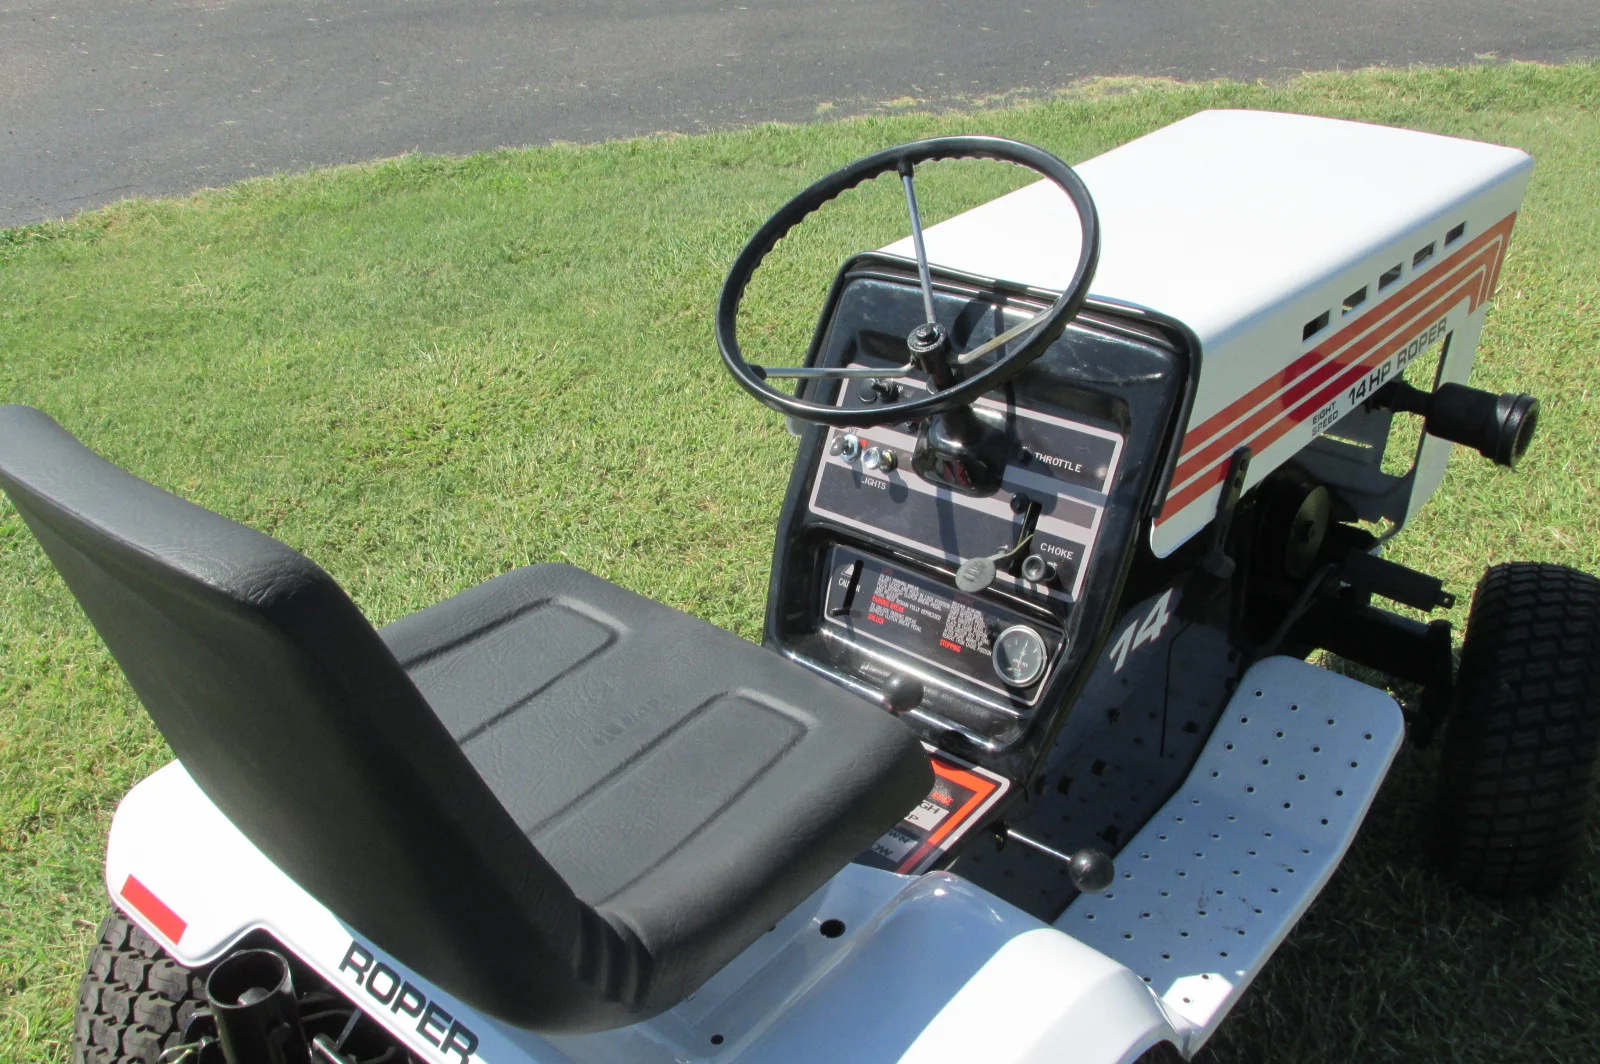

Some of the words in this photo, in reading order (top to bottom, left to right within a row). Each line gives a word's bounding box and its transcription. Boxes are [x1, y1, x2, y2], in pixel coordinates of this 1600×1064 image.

[1397, 317, 1447, 369] ROPER
[1311, 410, 1339, 436] SPEED
[1312, 401, 1336, 424] EIGHT
[1035, 452, 1083, 473] THROTTLE
[1040, 542, 1075, 560] CHOKE
[1109, 587, 1173, 674] 14
[338, 940, 479, 1064] ROPER
